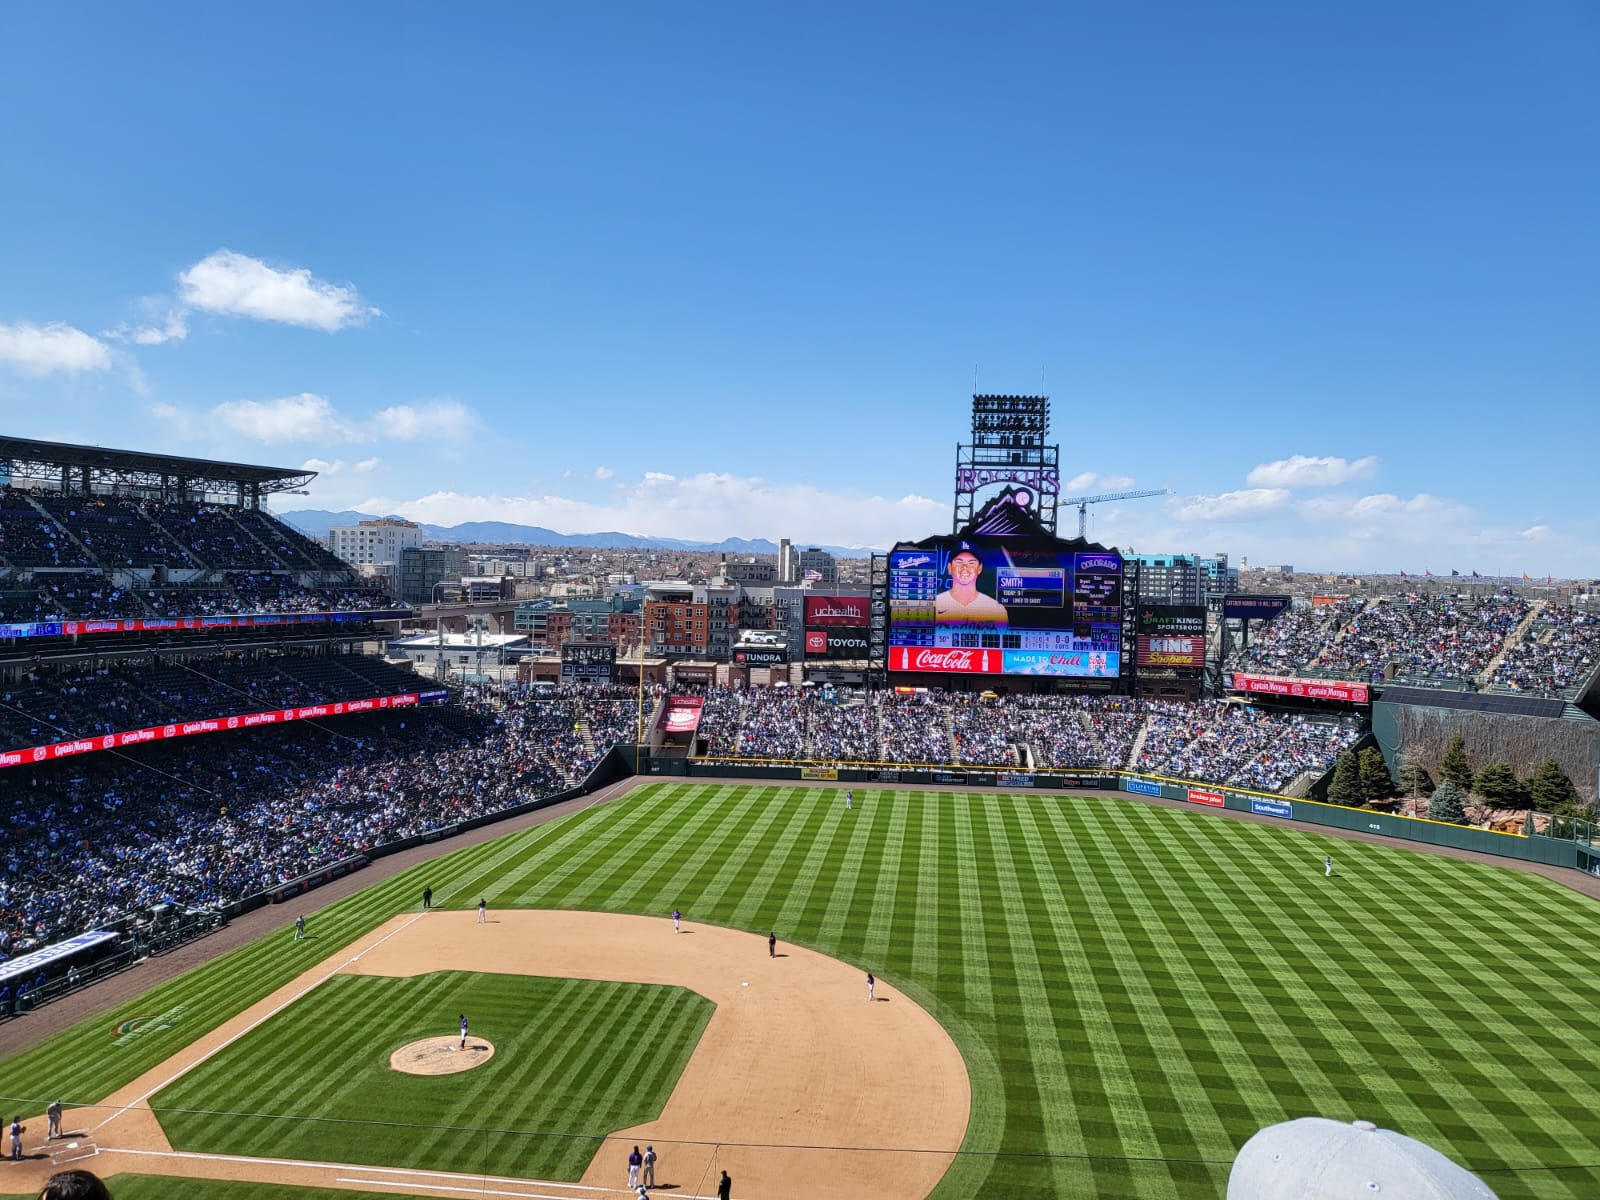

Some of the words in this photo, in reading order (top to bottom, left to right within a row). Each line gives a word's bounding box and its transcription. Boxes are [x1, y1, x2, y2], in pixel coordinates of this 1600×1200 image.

[957, 468, 1060, 494] ROCKIES
[1081, 559, 1118, 570] COLORADO
[1000, 577, 1023, 587] SMITH
[815, 604, 861, 617] uchealth
[828, 639, 868, 648] TOYOTA
[1149, 639, 1193, 652] KING
[916, 649, 974, 669] Coca-Cola
[1050, 654, 1082, 666] Chill
[1149, 652, 1193, 666] Soopers
[1250, 681, 1269, 690] Captain
[1268, 682, 1288, 693] Morgan
[1308, 686, 1328, 695] Captain
[1327, 687, 1348, 698] Morgan
[348, 702, 361, 712] Captain
[360, 700, 372, 710] Morgan
[392, 697, 404, 705] Captain
[403, 695, 414, 703] Morgan
[245, 714, 260, 726] Captain
[259, 712, 275, 723] Morgan
[299, 709, 314, 719] Captain
[313, 706, 327, 717] Morgan
[184, 723, 201, 734] Captain
[200, 720, 218, 732] Morgan
[122, 732, 139, 744] Captain
[138, 729, 154, 742] Morgan
[55, 743, 74, 757] Captain
[73, 741, 92, 754] Morgan
[1255, 804, 1285, 814] Southwest
